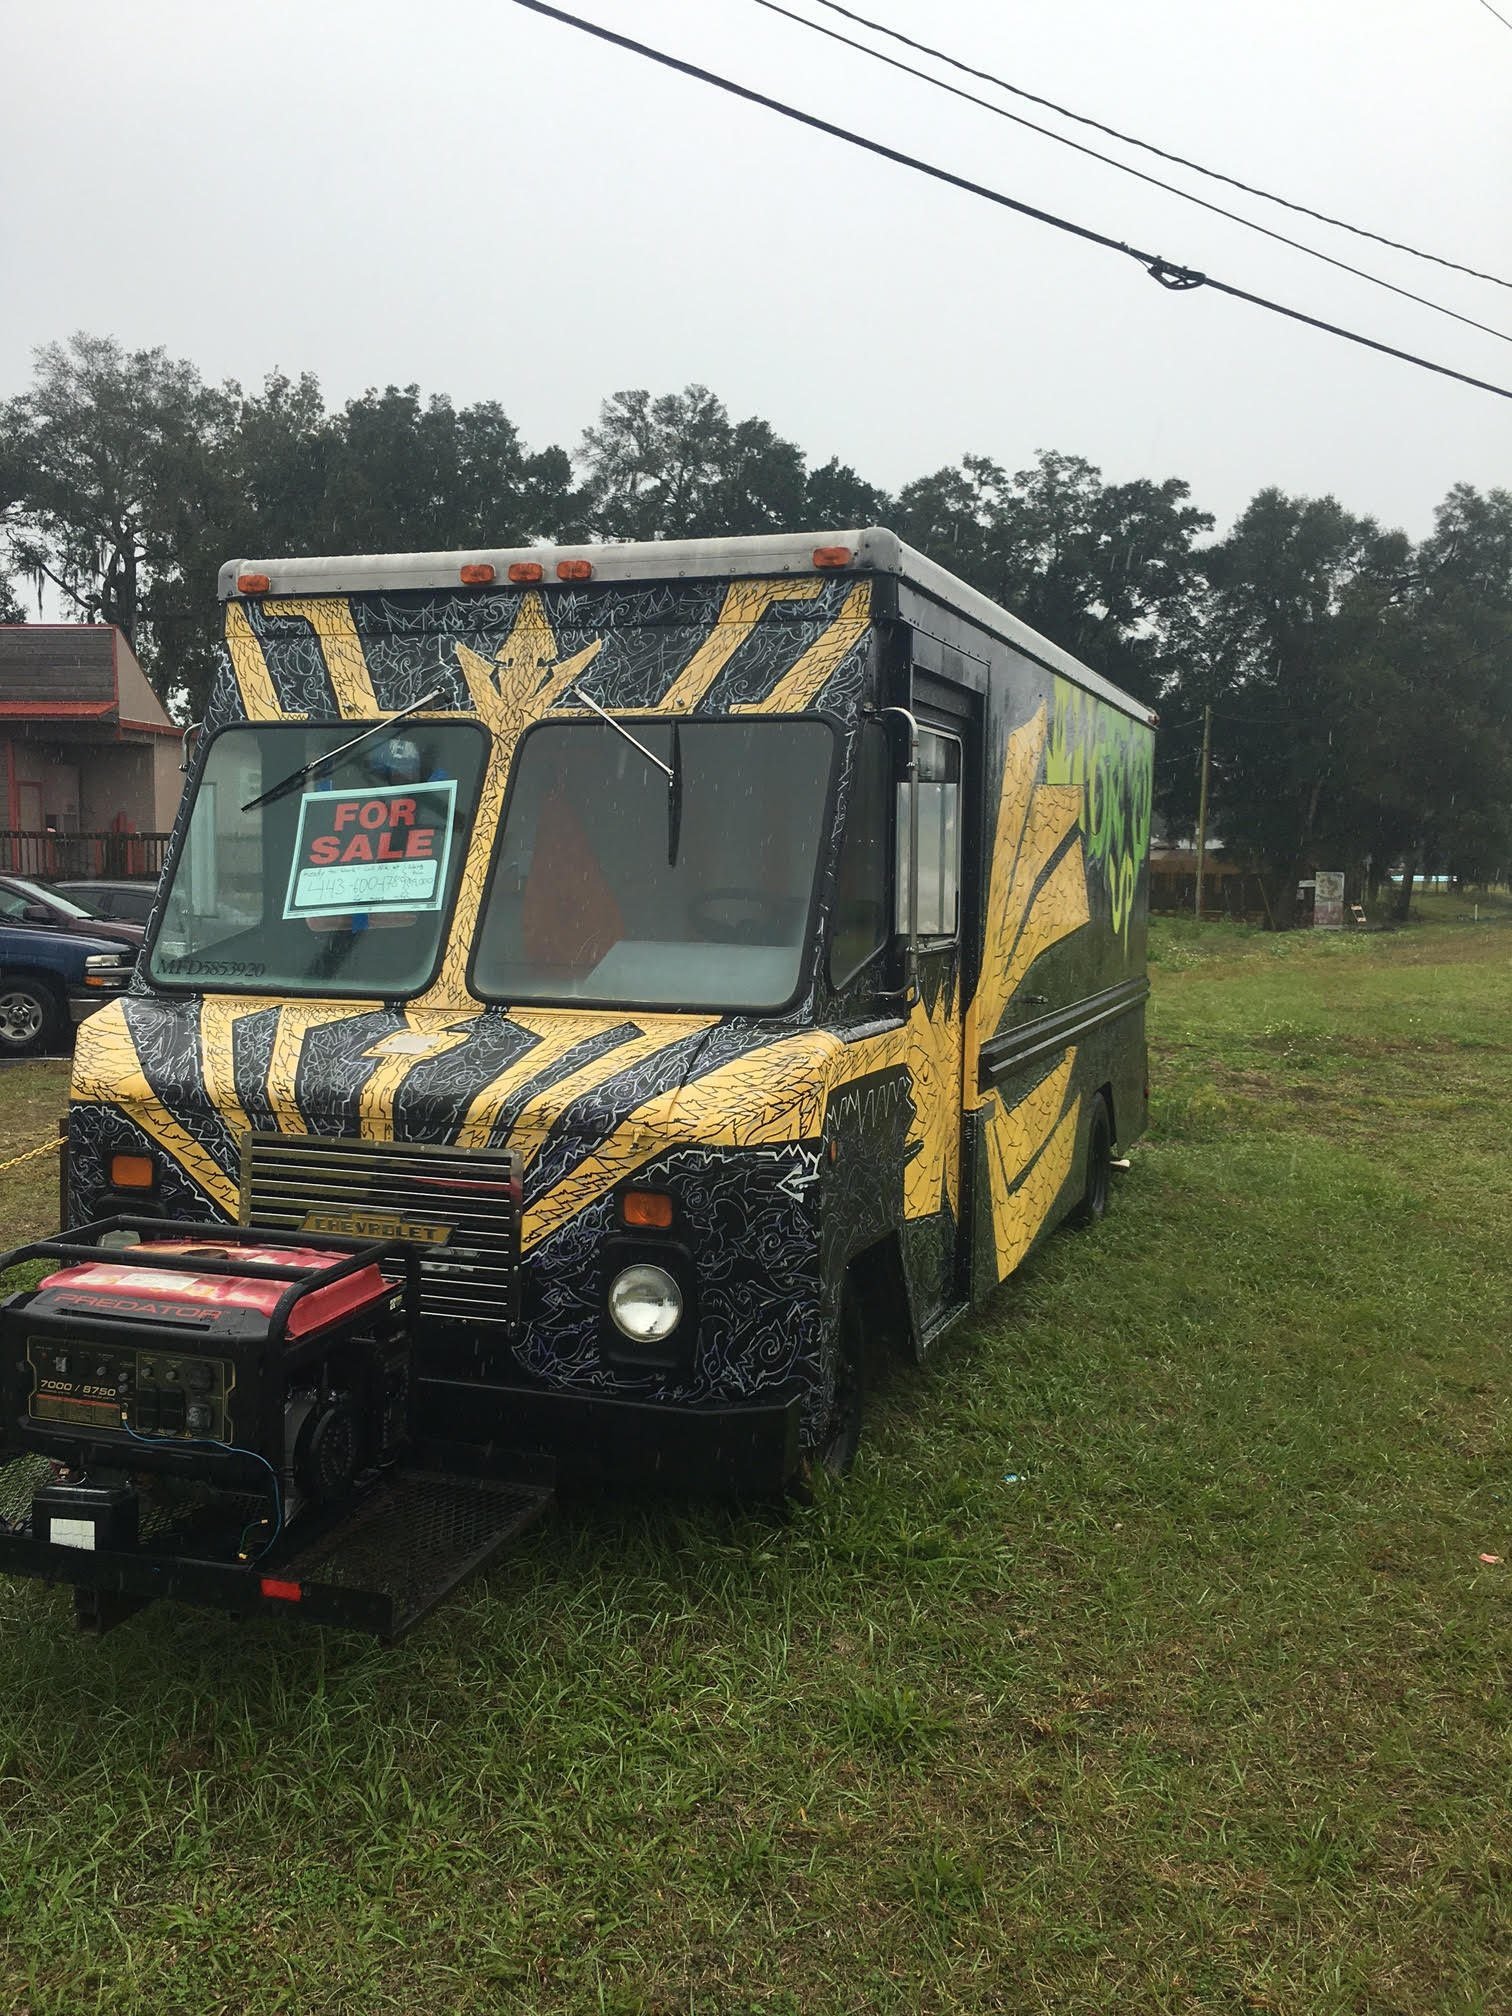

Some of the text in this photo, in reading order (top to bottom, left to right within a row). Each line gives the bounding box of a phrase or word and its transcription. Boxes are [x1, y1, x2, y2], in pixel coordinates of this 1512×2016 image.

[333, 798, 417, 832] FOR
[309, 829, 435, 865] SALE
[314, 1216, 439, 1241] CHEVROLET
[54, 1293, 223, 1320] PREDATOR
[40, 1379, 73, 1392] 7000
[82, 1385, 116, 1397] 8750
